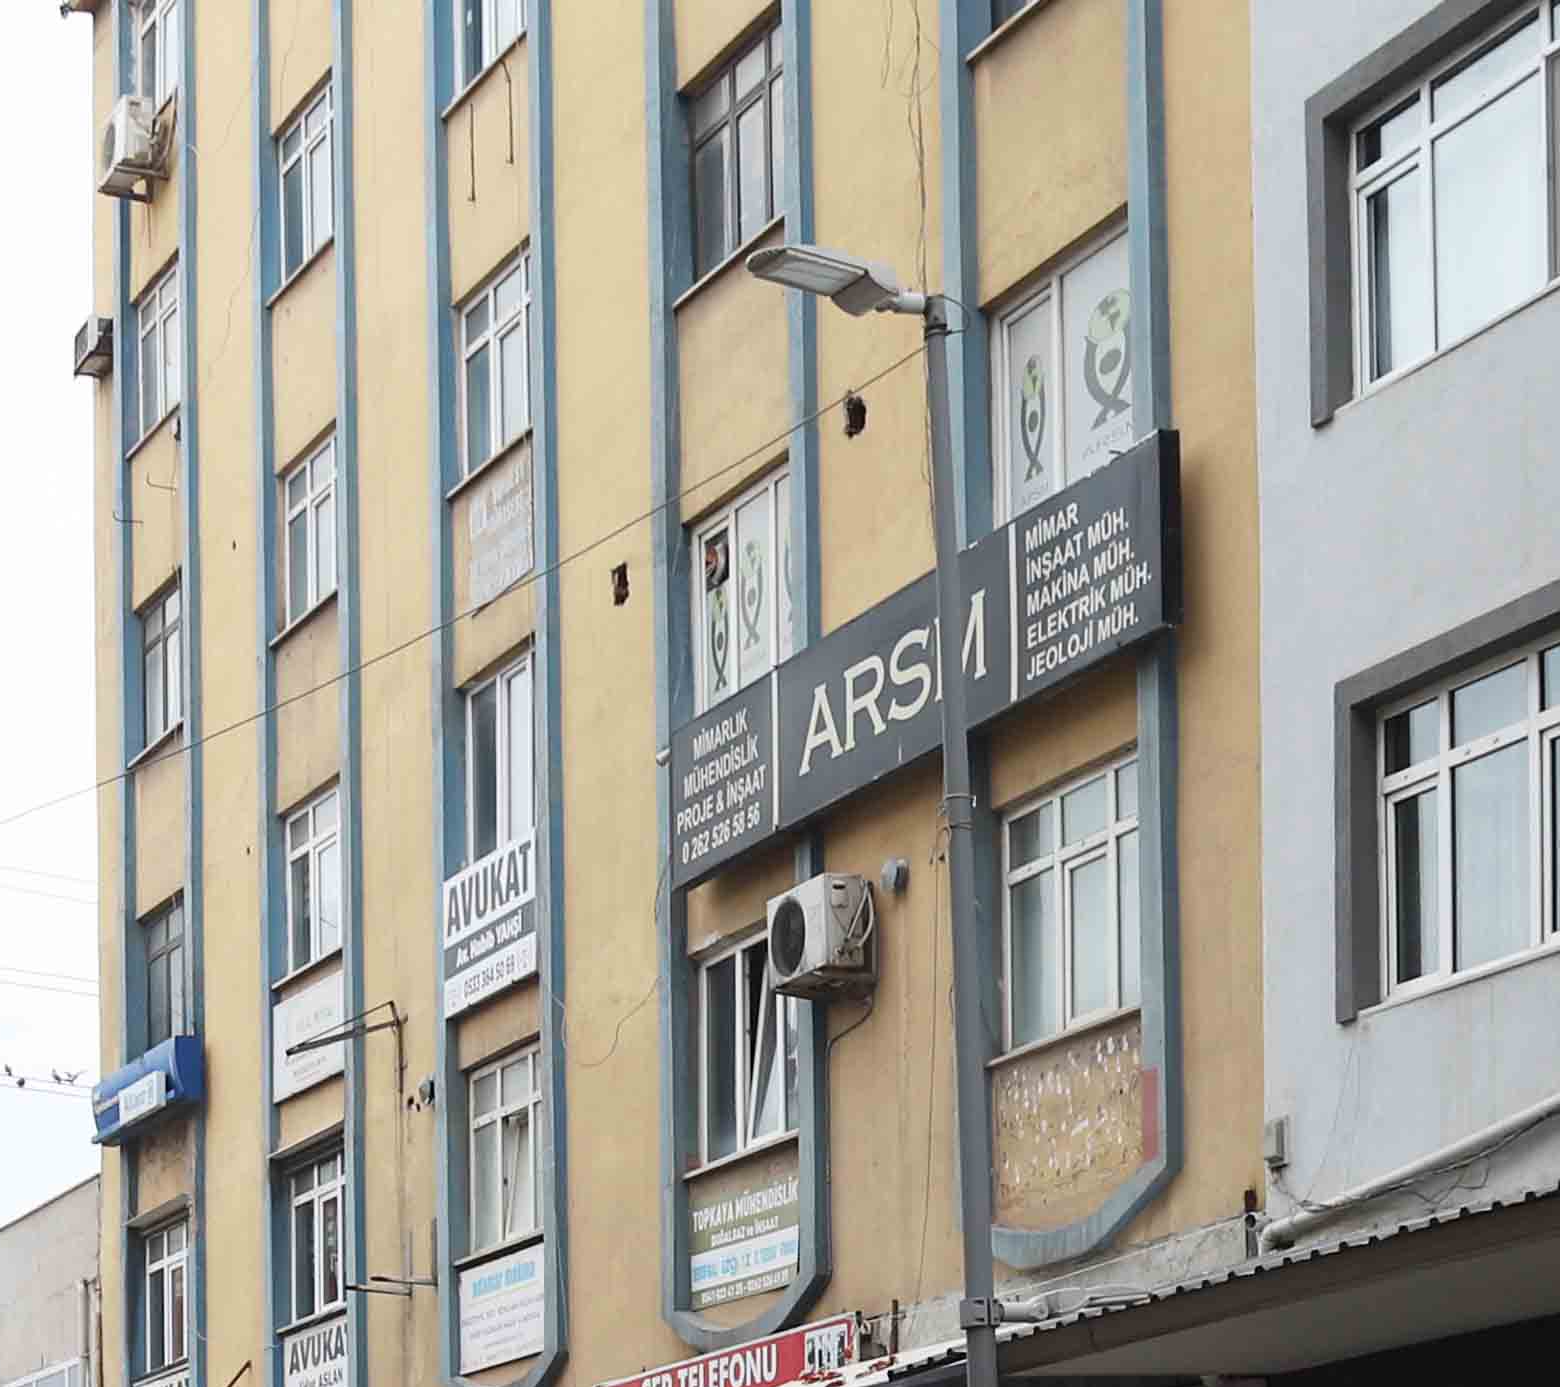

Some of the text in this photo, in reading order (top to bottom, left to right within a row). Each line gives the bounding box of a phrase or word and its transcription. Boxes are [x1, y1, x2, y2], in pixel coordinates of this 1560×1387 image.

[1025, 502, 1079, 552] MİMAR
[1026, 507, 1128, 584] İNŞAAT MÜH.
[1027, 537, 1135, 616] MAKİNA MÜH.
[1027, 561, 1151, 648] ELEKTRİK MÜH.
[1027, 602, 1139, 680] JEOLOJİ MÜH.
[684, 732, 759, 800] MÜHENDİSLİK
[693, 707, 748, 761] MİMARLIK
[677, 793, 714, 835] PROJE
[726, 764, 767, 810] İNŞAAT
[691, 830, 709, 860] 262
[448, 840, 531, 937] AVUKAT
